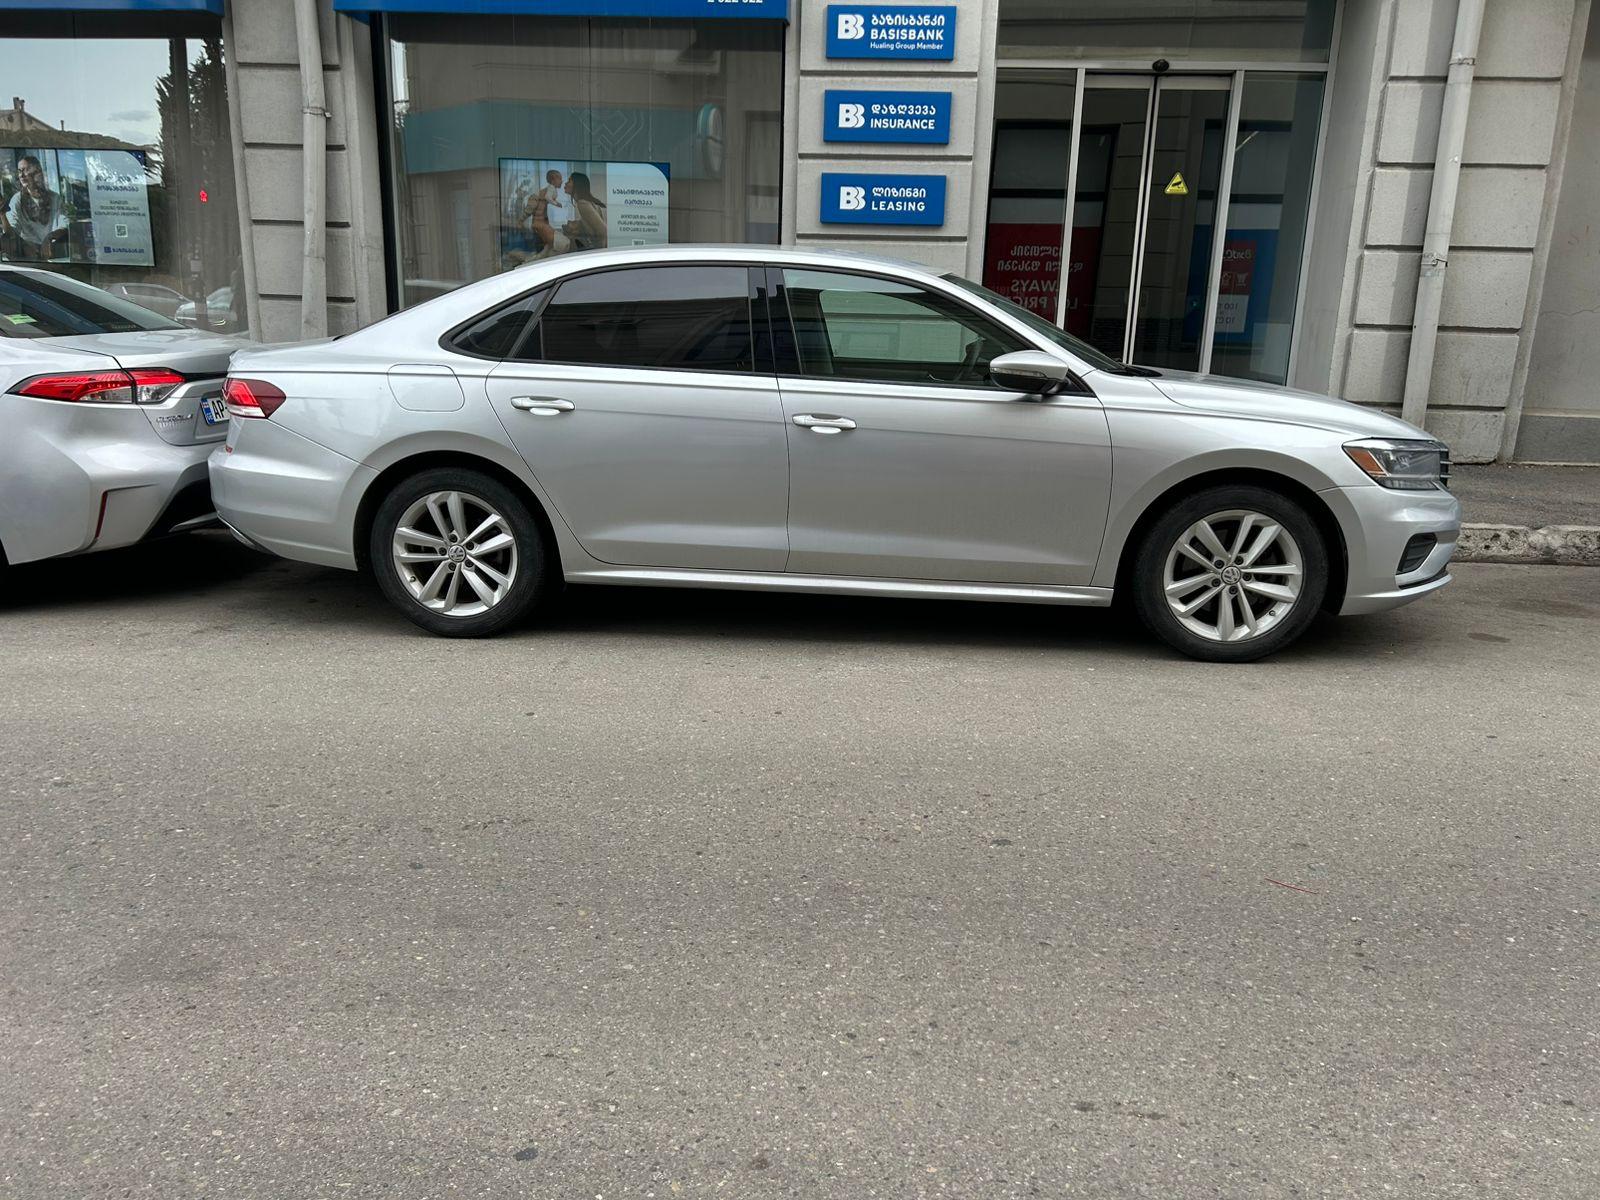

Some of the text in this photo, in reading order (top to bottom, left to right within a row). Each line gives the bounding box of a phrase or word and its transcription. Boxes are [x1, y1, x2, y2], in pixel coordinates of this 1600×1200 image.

[871, 14, 945, 26] ბაზისბანკი
[870, 29, 944, 40] BASISBANK
[870, 42, 894, 50] Hualing
[895, 42, 915, 50] Group
[871, 104, 936, 115] დაზღვევა
[870, 118, 935, 129] INSURANCE
[872, 187, 926, 198] ლიზინგი
[871, 201, 926, 211] LEASING
